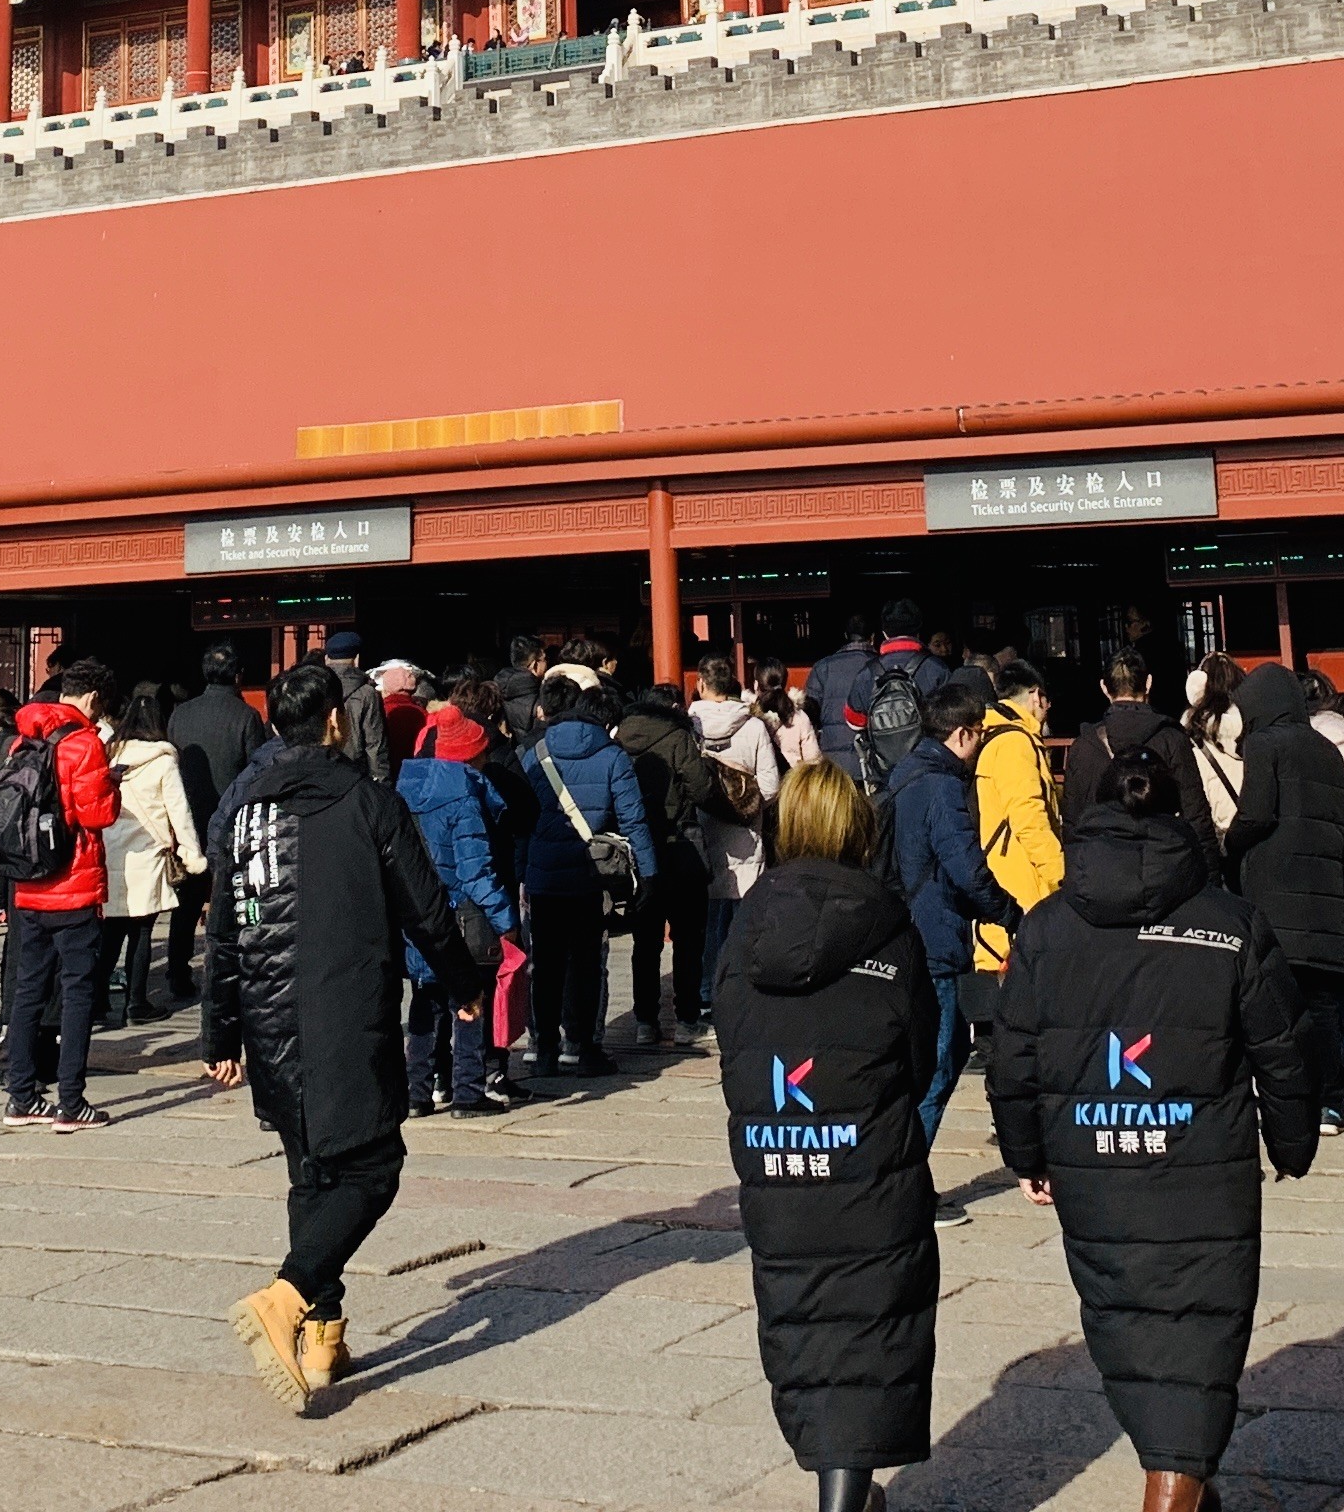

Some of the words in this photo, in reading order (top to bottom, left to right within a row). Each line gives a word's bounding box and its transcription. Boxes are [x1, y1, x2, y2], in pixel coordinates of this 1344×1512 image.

[970, 470, 1162, 501] 检票及安检入口
[970, 503, 1005, 517] Ticket
[1007, 500, 1027, 514] and
[1030, 498, 1075, 514] Security
[1077, 496, 1110, 510] Check
[1113, 494, 1163, 508] Entrance
[220, 520, 370, 548] 检票及安检入口
[220, 550, 246, 562] Ticket
[248, 548, 264, 560] and
[266, 546, 301, 559] Security
[303, 544, 329, 556] Check
[331, 542, 370, 554] Entrance
[1139, 925, 1175, 936] LIFE
[1183, 928, 1244, 948] ACTIVE
[1075, 1103, 1193, 1126] KAITAIM
[745, 1124, 857, 1149] KAITAIM
[1095, 1130, 1167, 1154] 凯泰铭
[764, 1153, 831, 1178] 凯泰铭
